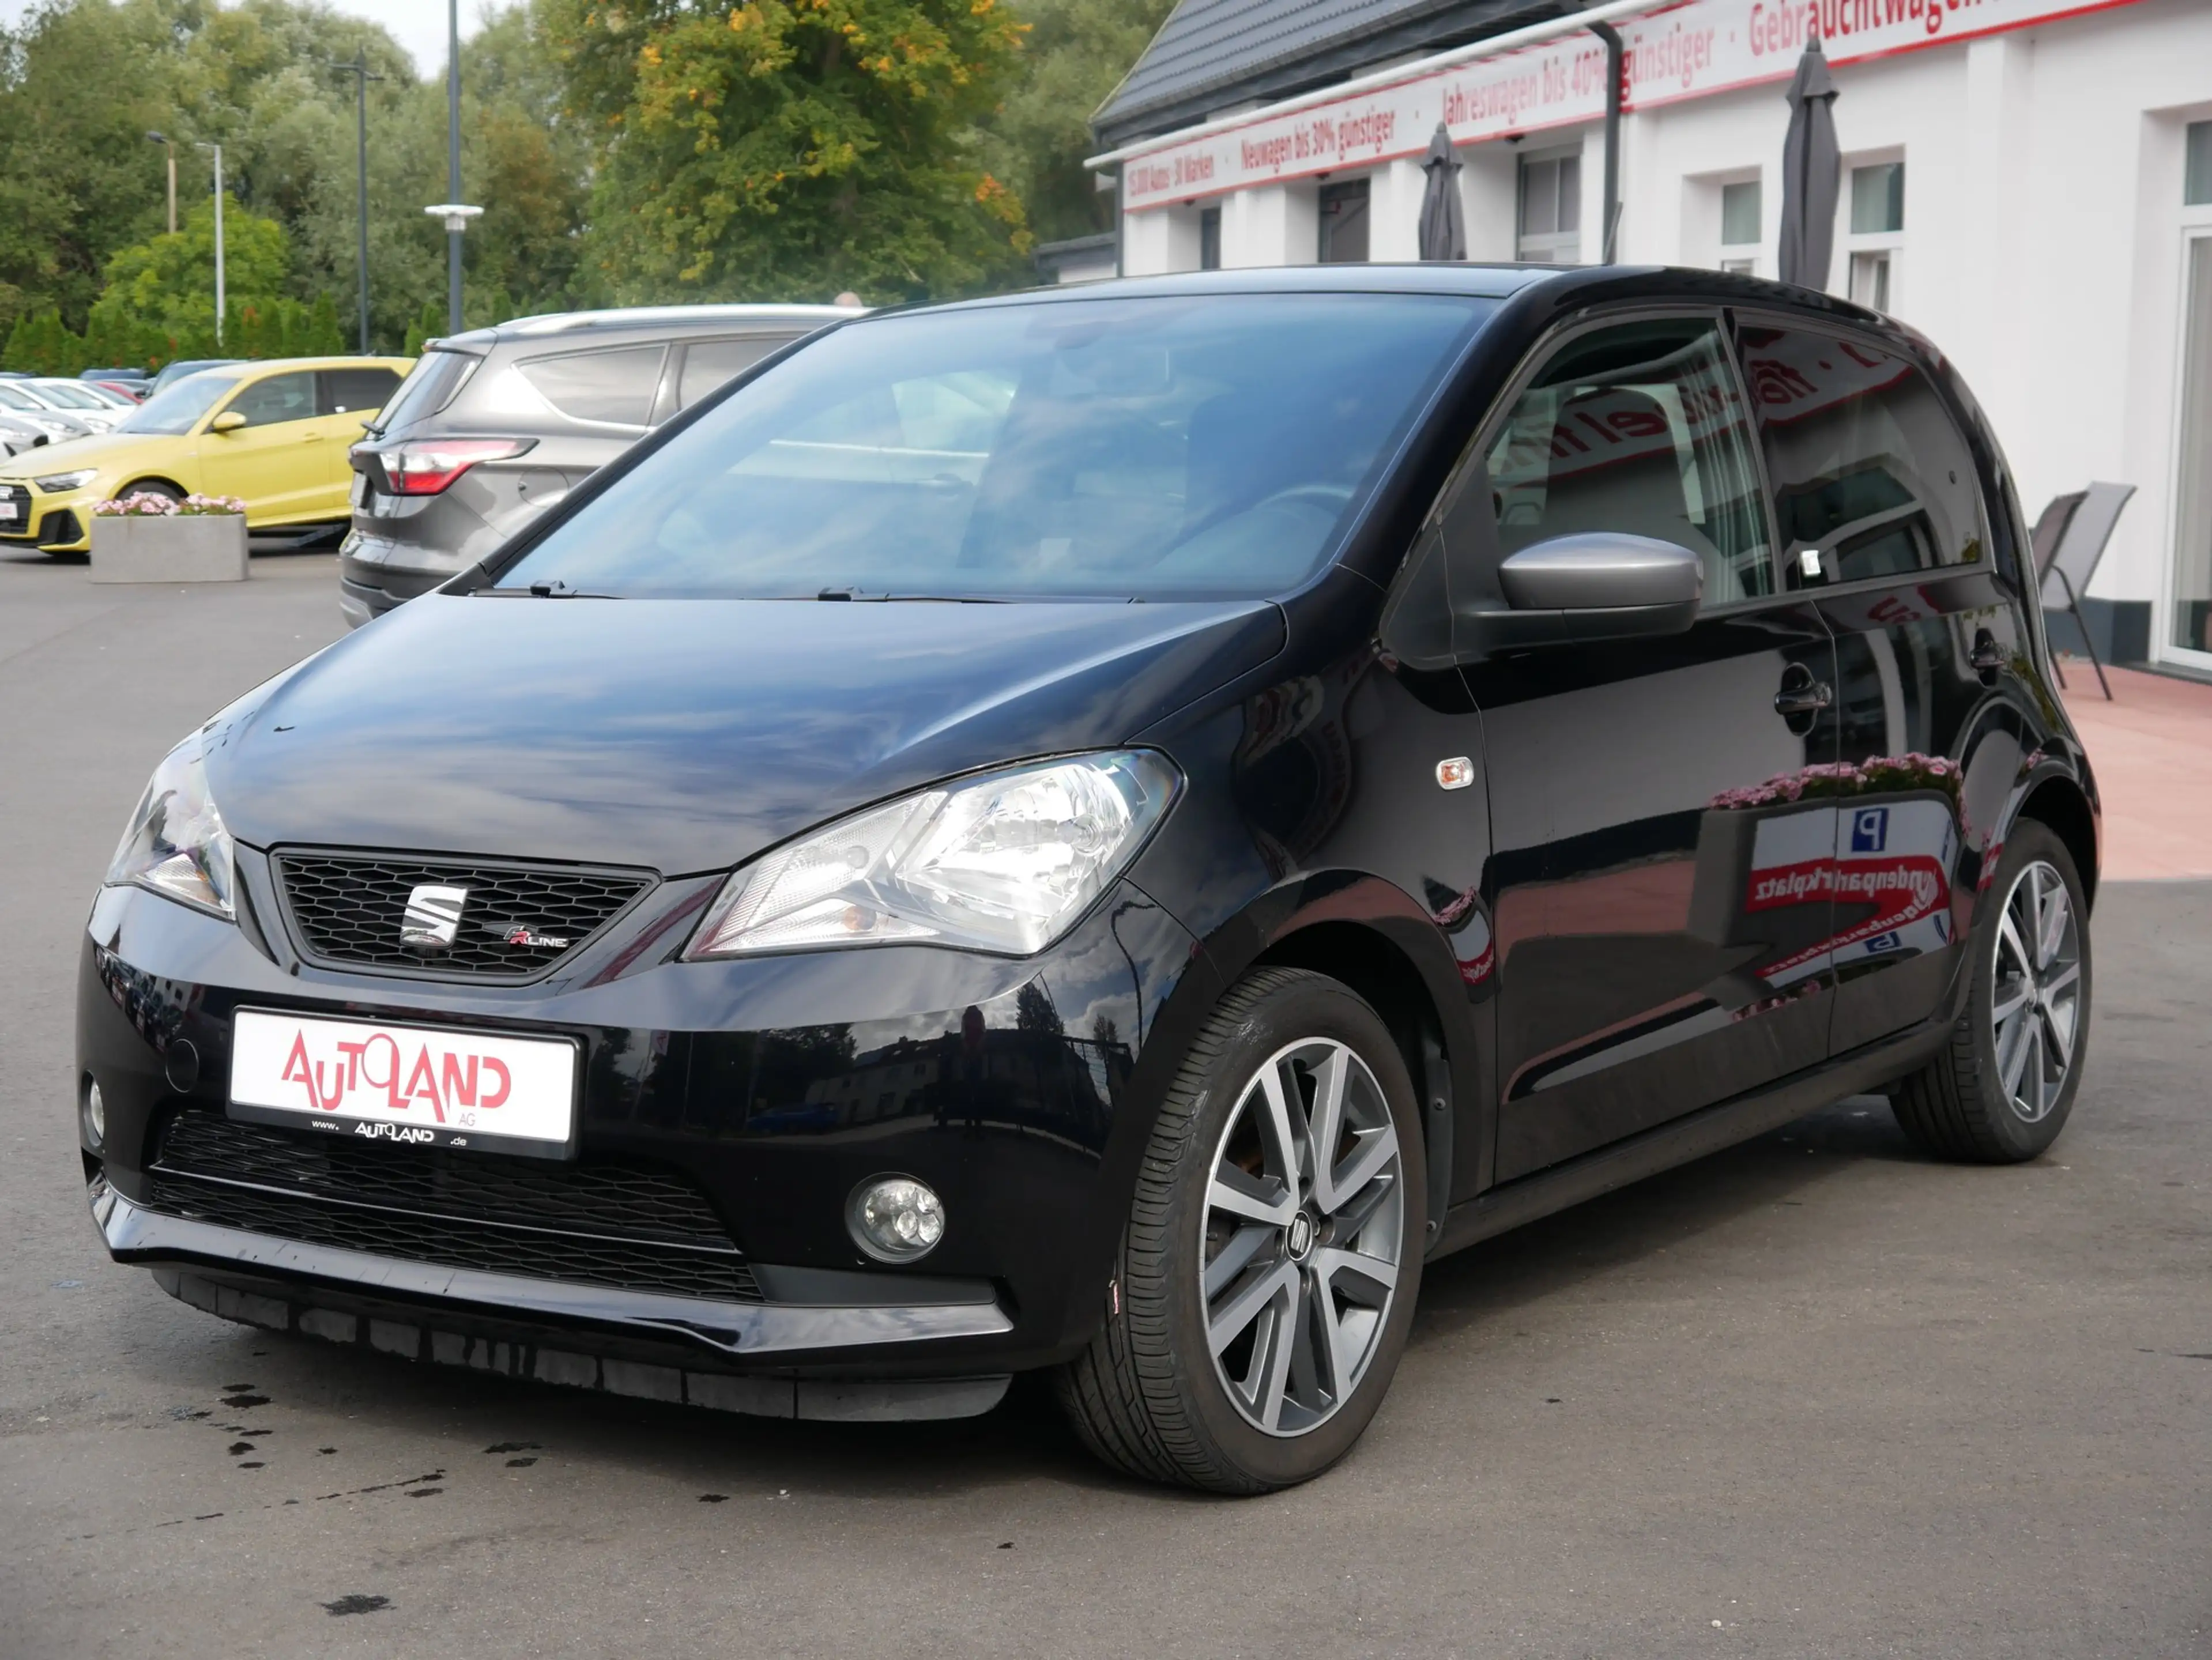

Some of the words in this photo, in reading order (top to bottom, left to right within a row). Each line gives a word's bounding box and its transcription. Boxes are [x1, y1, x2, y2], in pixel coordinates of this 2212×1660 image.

[1242, 136, 1291, 173] Neuwagen
[1294, 122, 1309, 159] bis
[1312, 117, 1335, 155] 30%
[1339, 104, 1395, 161] günstiger
[1442, 82, 1538, 126] Jahreswagen
[1543, 55, 1566, 103] bis
[1619, 22, 1716, 102] günstiger
[312, 1120, 340, 1131] www.
[450, 1137, 468, 1146] .de
[458, 1113, 476, 1127] AG
